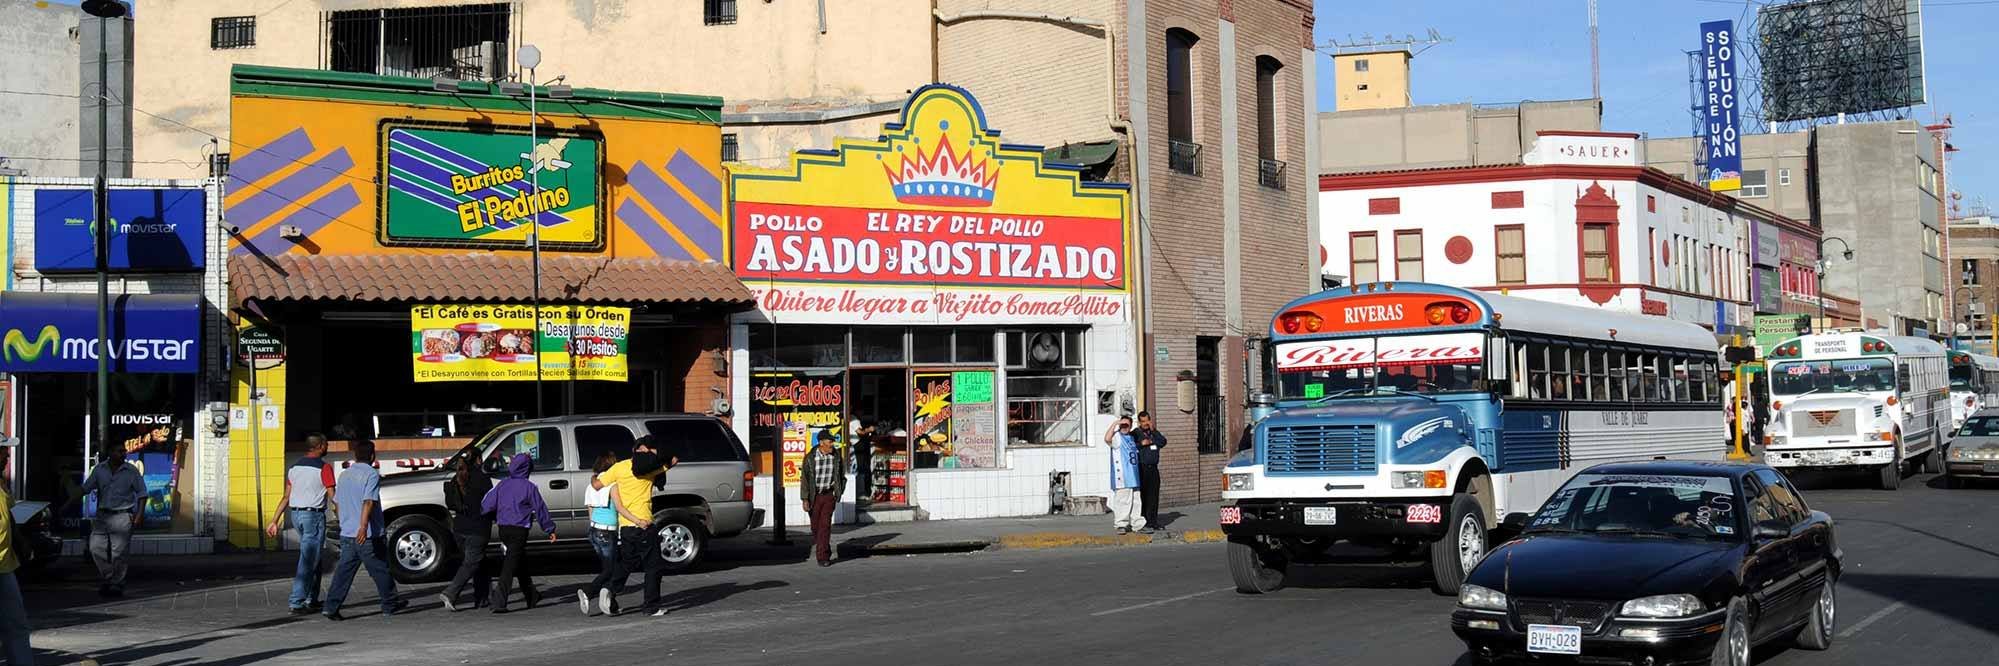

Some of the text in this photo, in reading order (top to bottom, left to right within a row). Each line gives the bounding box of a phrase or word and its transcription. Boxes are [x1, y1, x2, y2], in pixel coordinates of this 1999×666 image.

[1706, 32, 1721, 158] SIEMPRE UNA
[1718, 31, 1736, 157] SOLUCIÓN
[1567, 144, 1620, 159] SAUER
[451, 164, 524, 196] Burritos
[457, 187, 570, 233] El Padrino
[121, 223, 177, 234] movistar
[749, 213, 823, 232] POLLO
[867, 212, 1044, 237] EL REY DEL POLLO
[746, 234, 881, 274] ASADO
[900, 239, 1118, 280] ROSTIZADO
[438, 307, 469, 319] Café
[473, 310, 489, 319] es
[493, 307, 533, 319] Gratis
[538, 310, 562, 319] con
[566, 310, 581, 319] su
[585, 308, 624, 321] Orden
[763, 288, 836, 312] Quiere
[838, 290, 907, 320] llegar
[911, 299, 928, 314] a
[933, 292, 1003, 321] Viejito
[1006, 293, 1063, 315] Coma
[1344, 303, 1404, 324] RIVERAS
[546, 321, 625, 340] Desayunos desde
[63, 337, 194, 361] movistar
[576, 339, 586, 356] 30
[586, 339, 618, 357] Pesitos
[1278, 344, 1481, 366] Riveras
[432, 370, 469, 379] Desayuno
[507, 369, 537, 377] Tortillas
[592, 368, 603, 376] del
[605, 370, 626, 378] comal
[578, 360, 587, 368] 15
[789, 379, 842, 406] Caldos
[913, 379, 951, 411] Pollos
[111, 413, 173, 425] movistar
[784, 440, 806, 452] 090
[784, 460, 797, 477] 3
[1406, 505, 1441, 523] 2234
